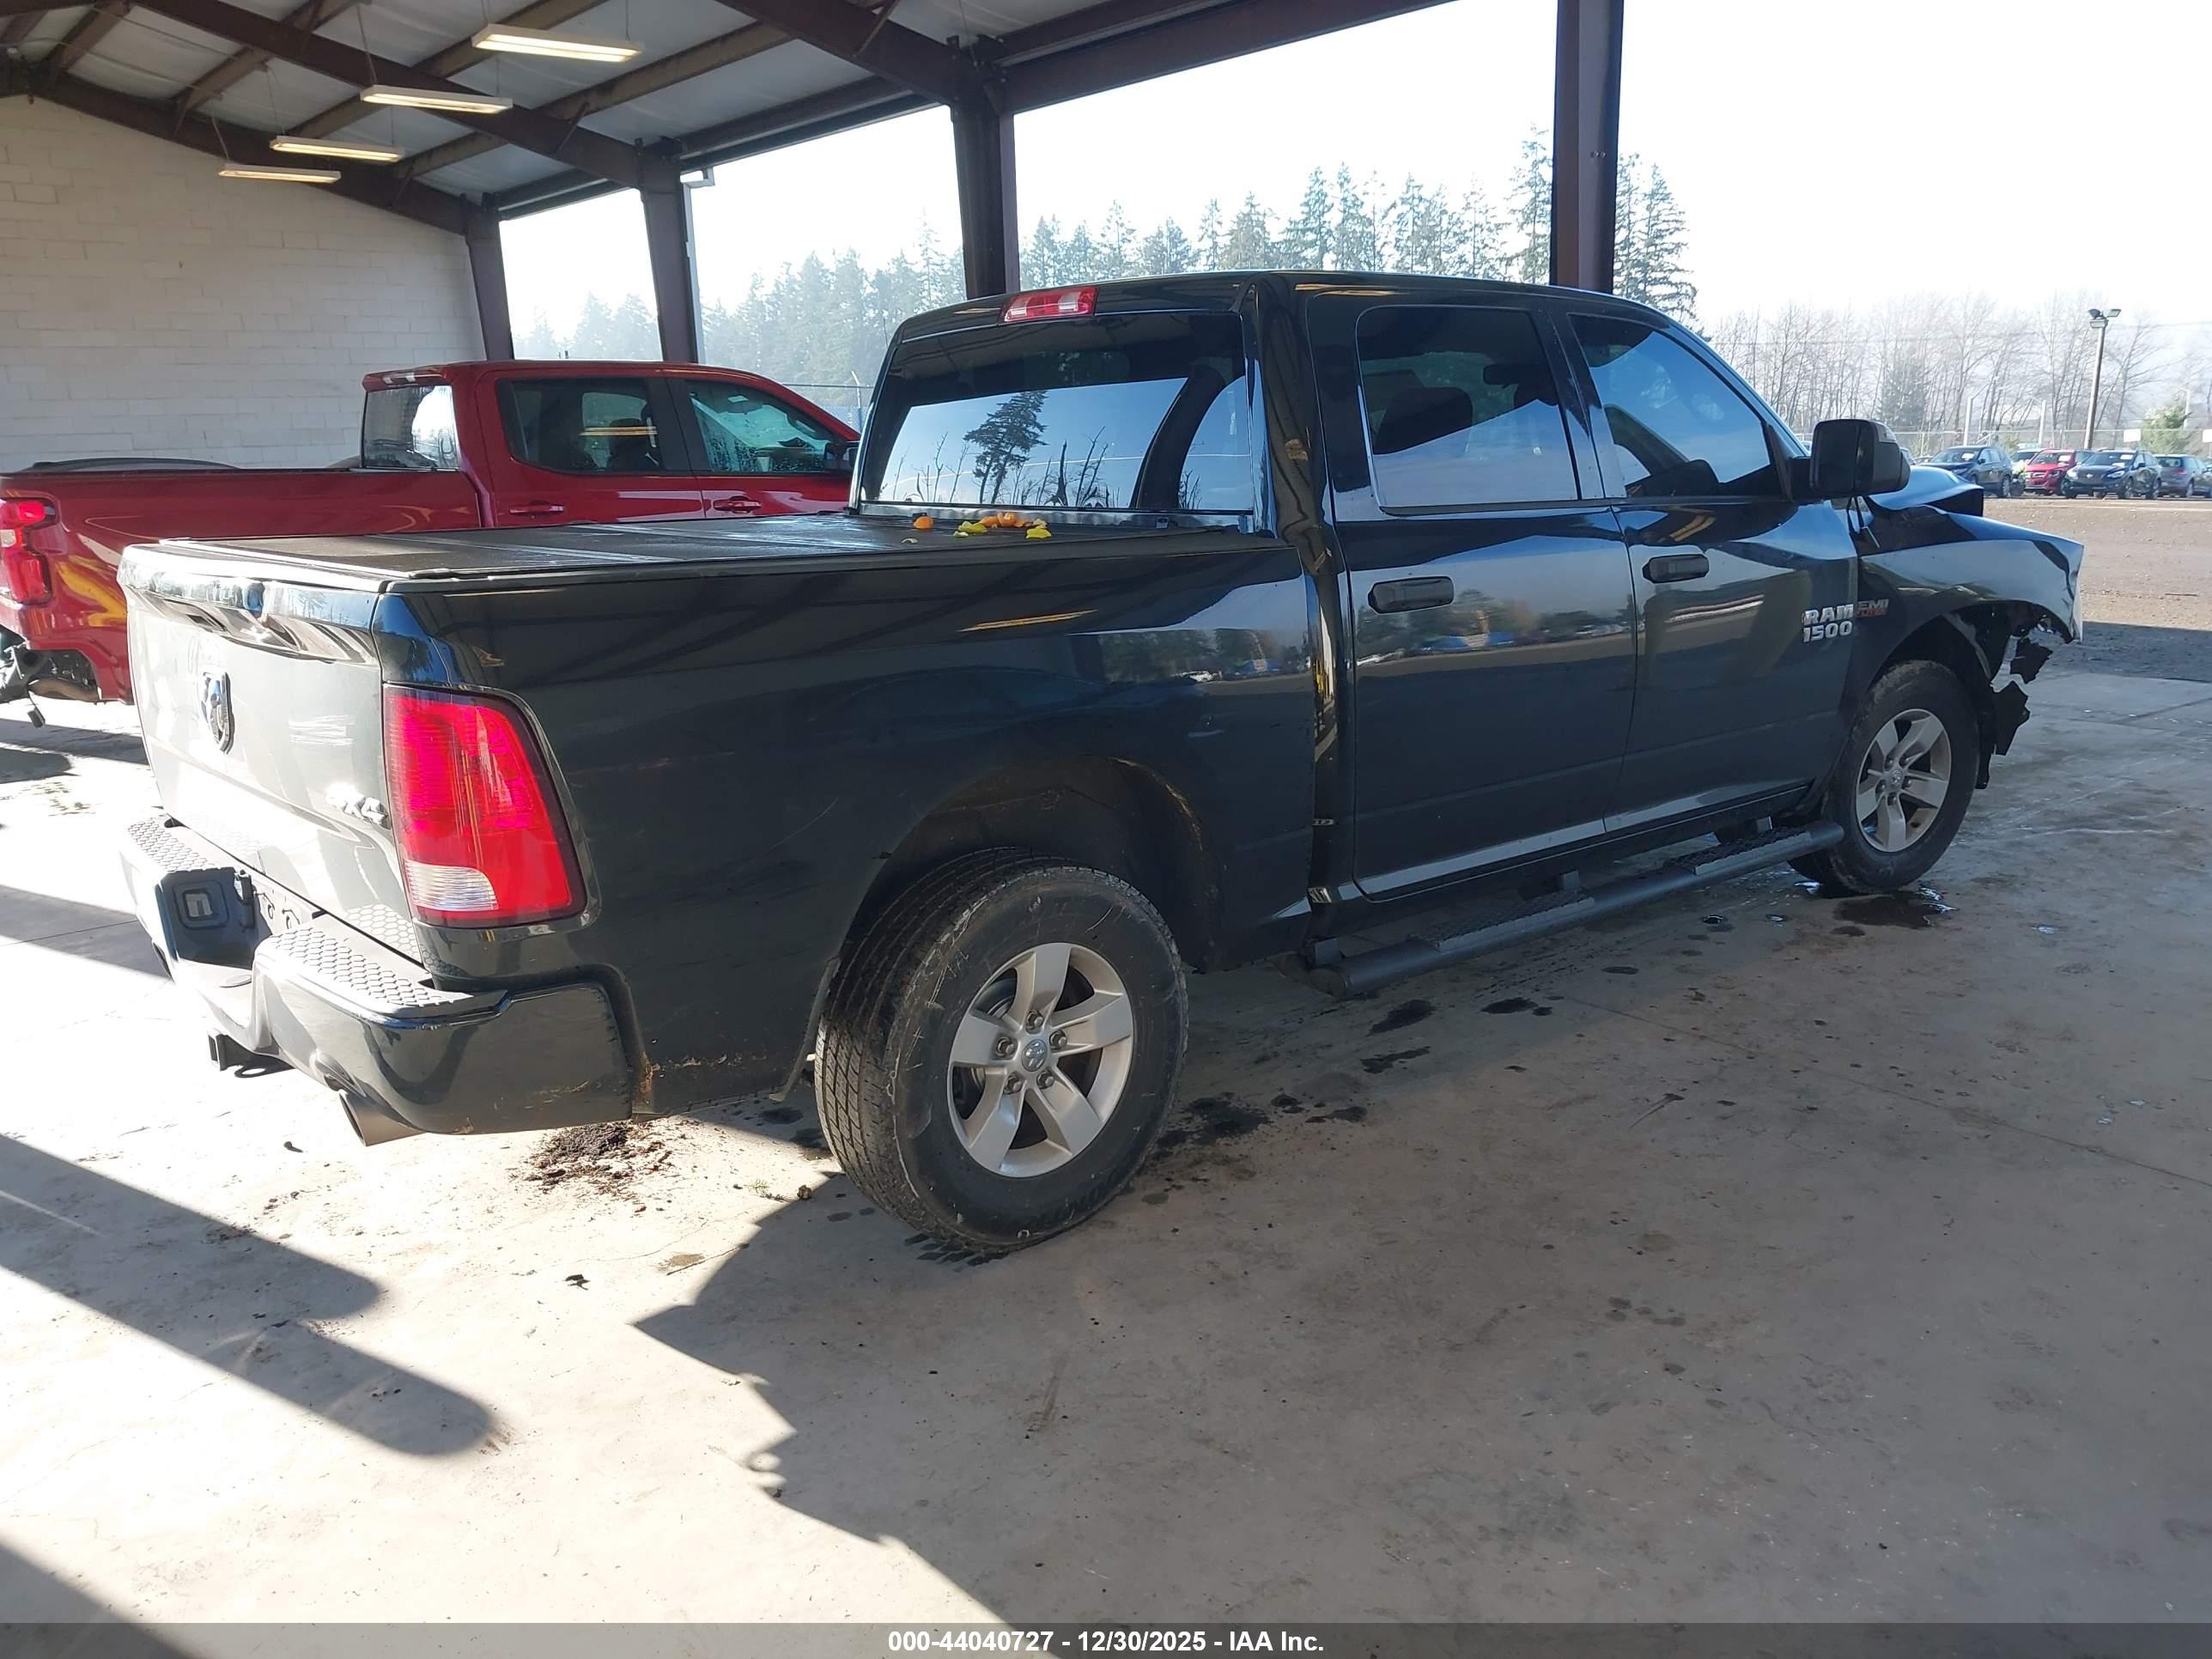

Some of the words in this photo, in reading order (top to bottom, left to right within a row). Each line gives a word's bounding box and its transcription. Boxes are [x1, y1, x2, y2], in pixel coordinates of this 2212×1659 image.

[1803, 604, 1854, 625] RAM
[1856, 599, 1889, 610] EMI
[1803, 620, 1853, 643] 1500
